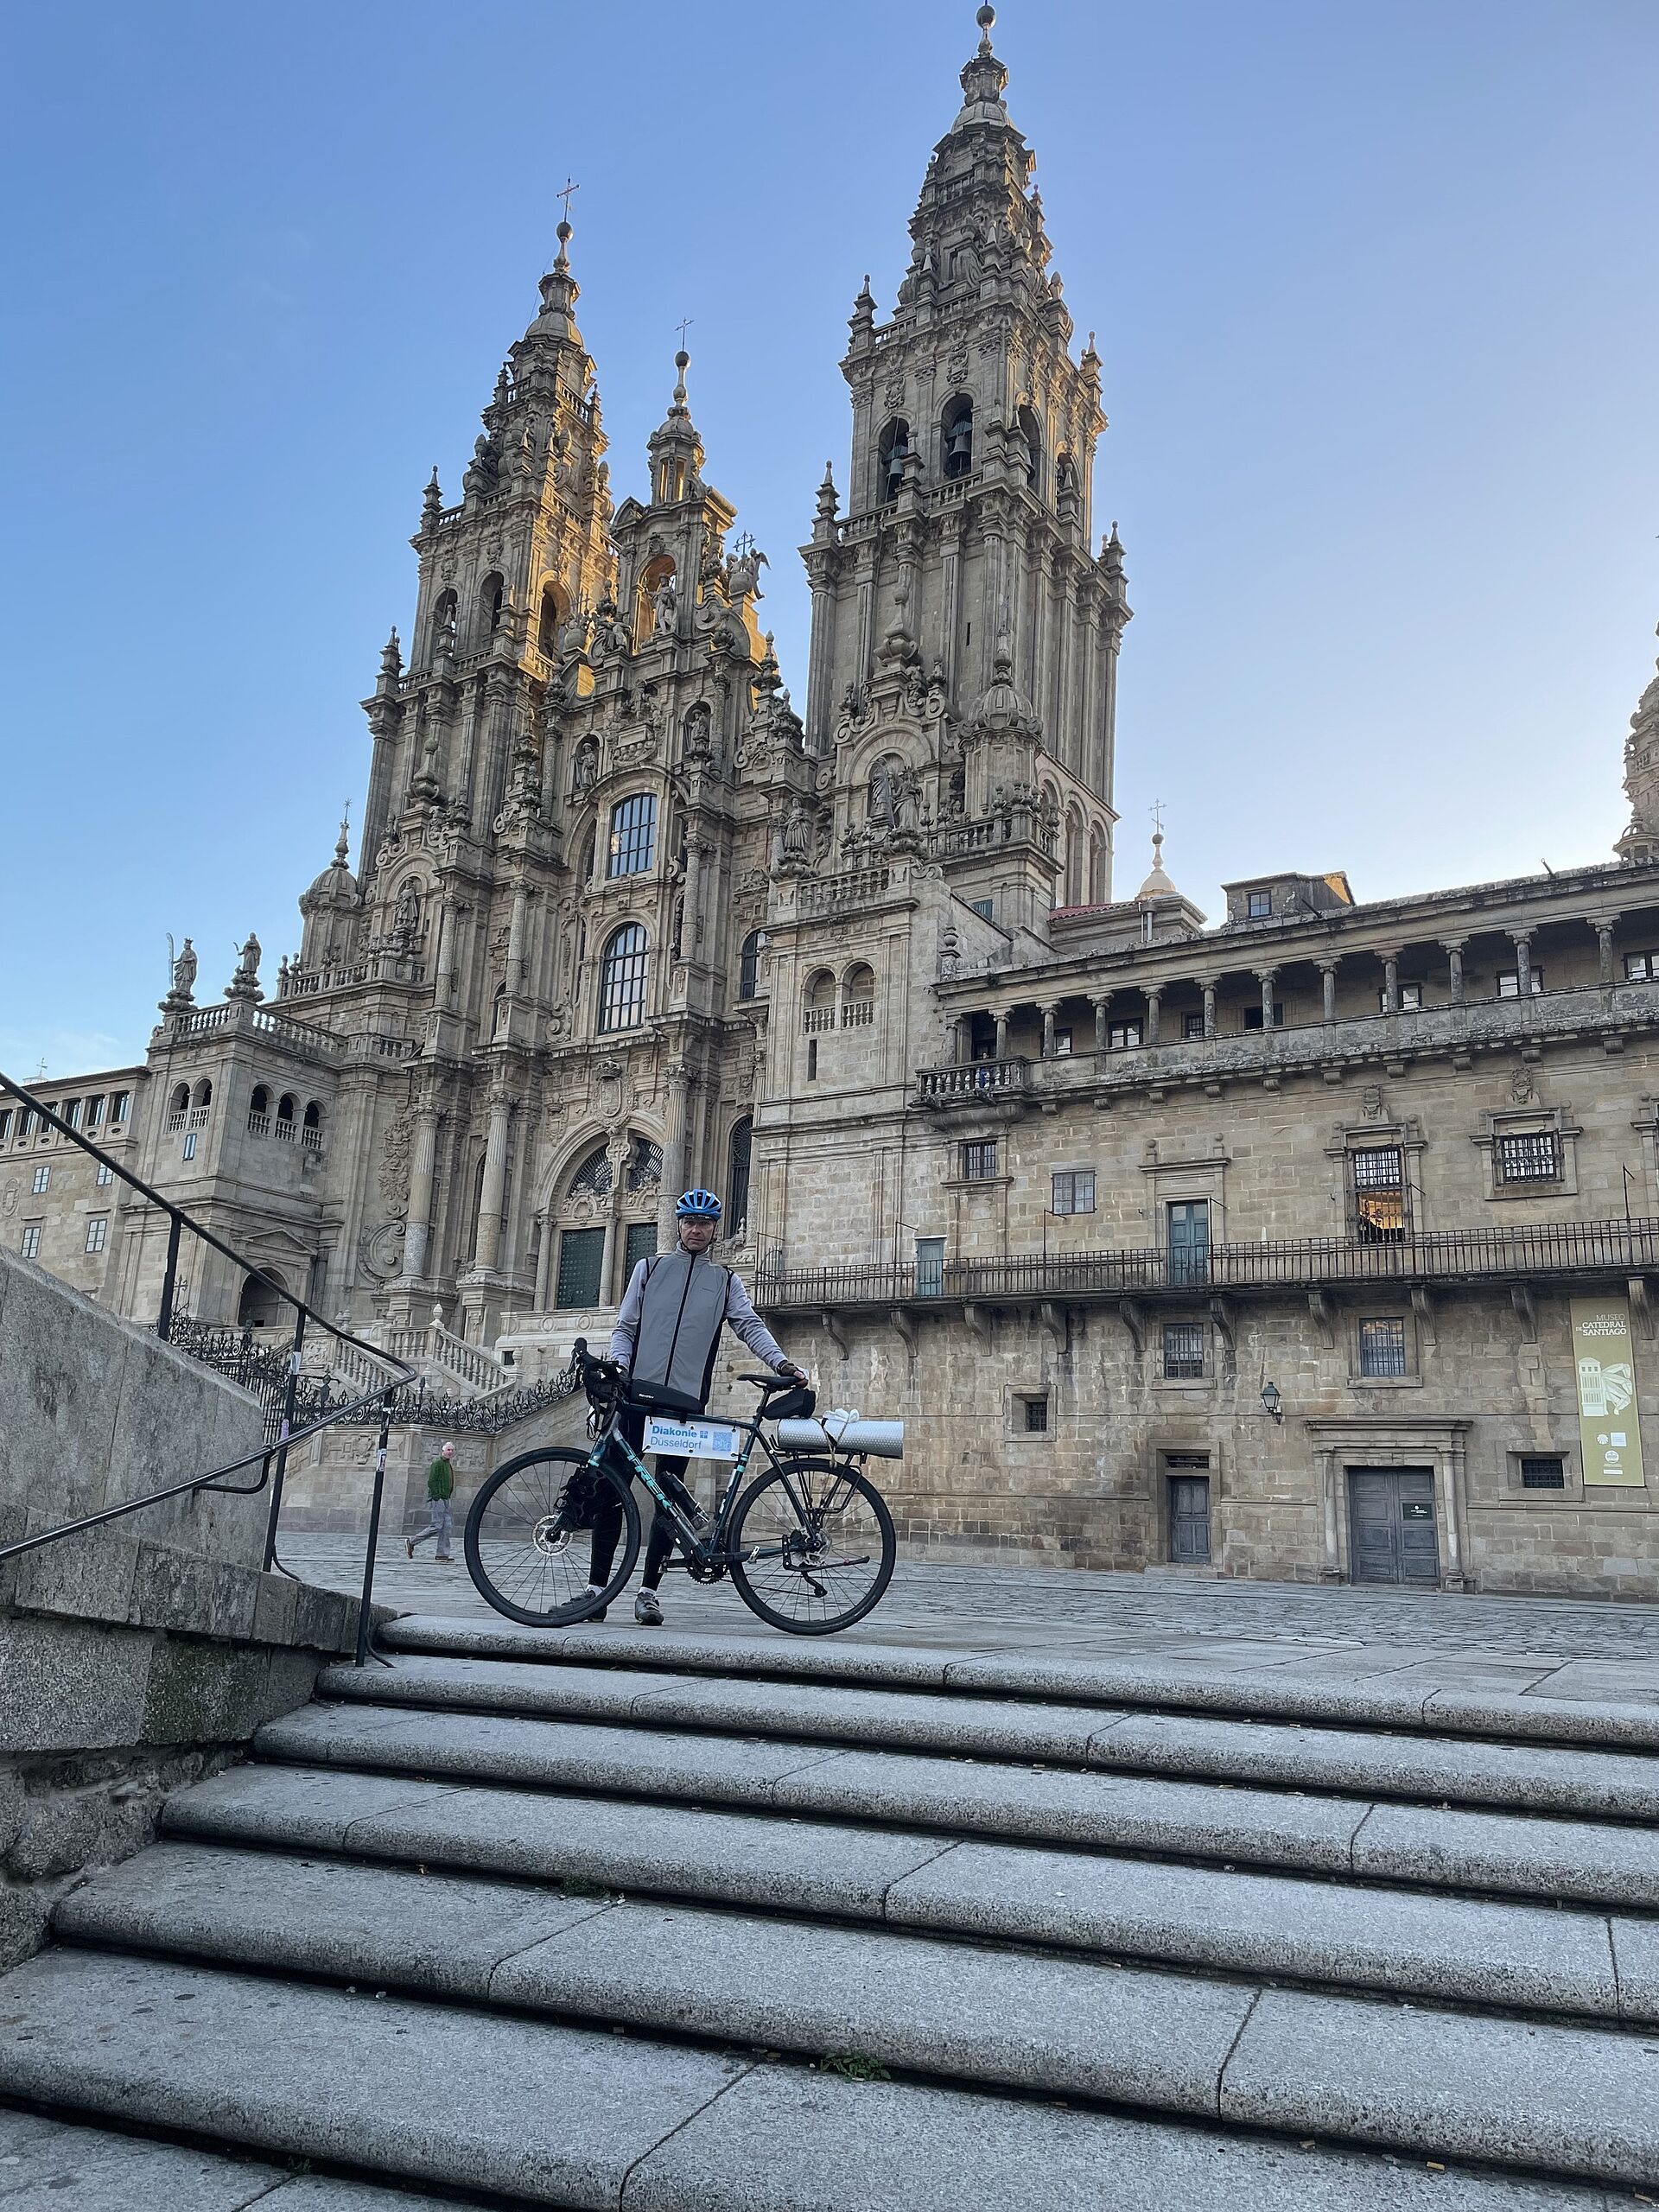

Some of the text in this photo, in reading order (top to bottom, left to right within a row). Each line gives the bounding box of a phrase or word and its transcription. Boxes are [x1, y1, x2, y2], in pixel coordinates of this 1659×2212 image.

[652, 1425, 697, 1438] Diakonie
[650, 1436, 702, 1449] Düsseldorf
[626, 1448, 672, 1510] TREK
